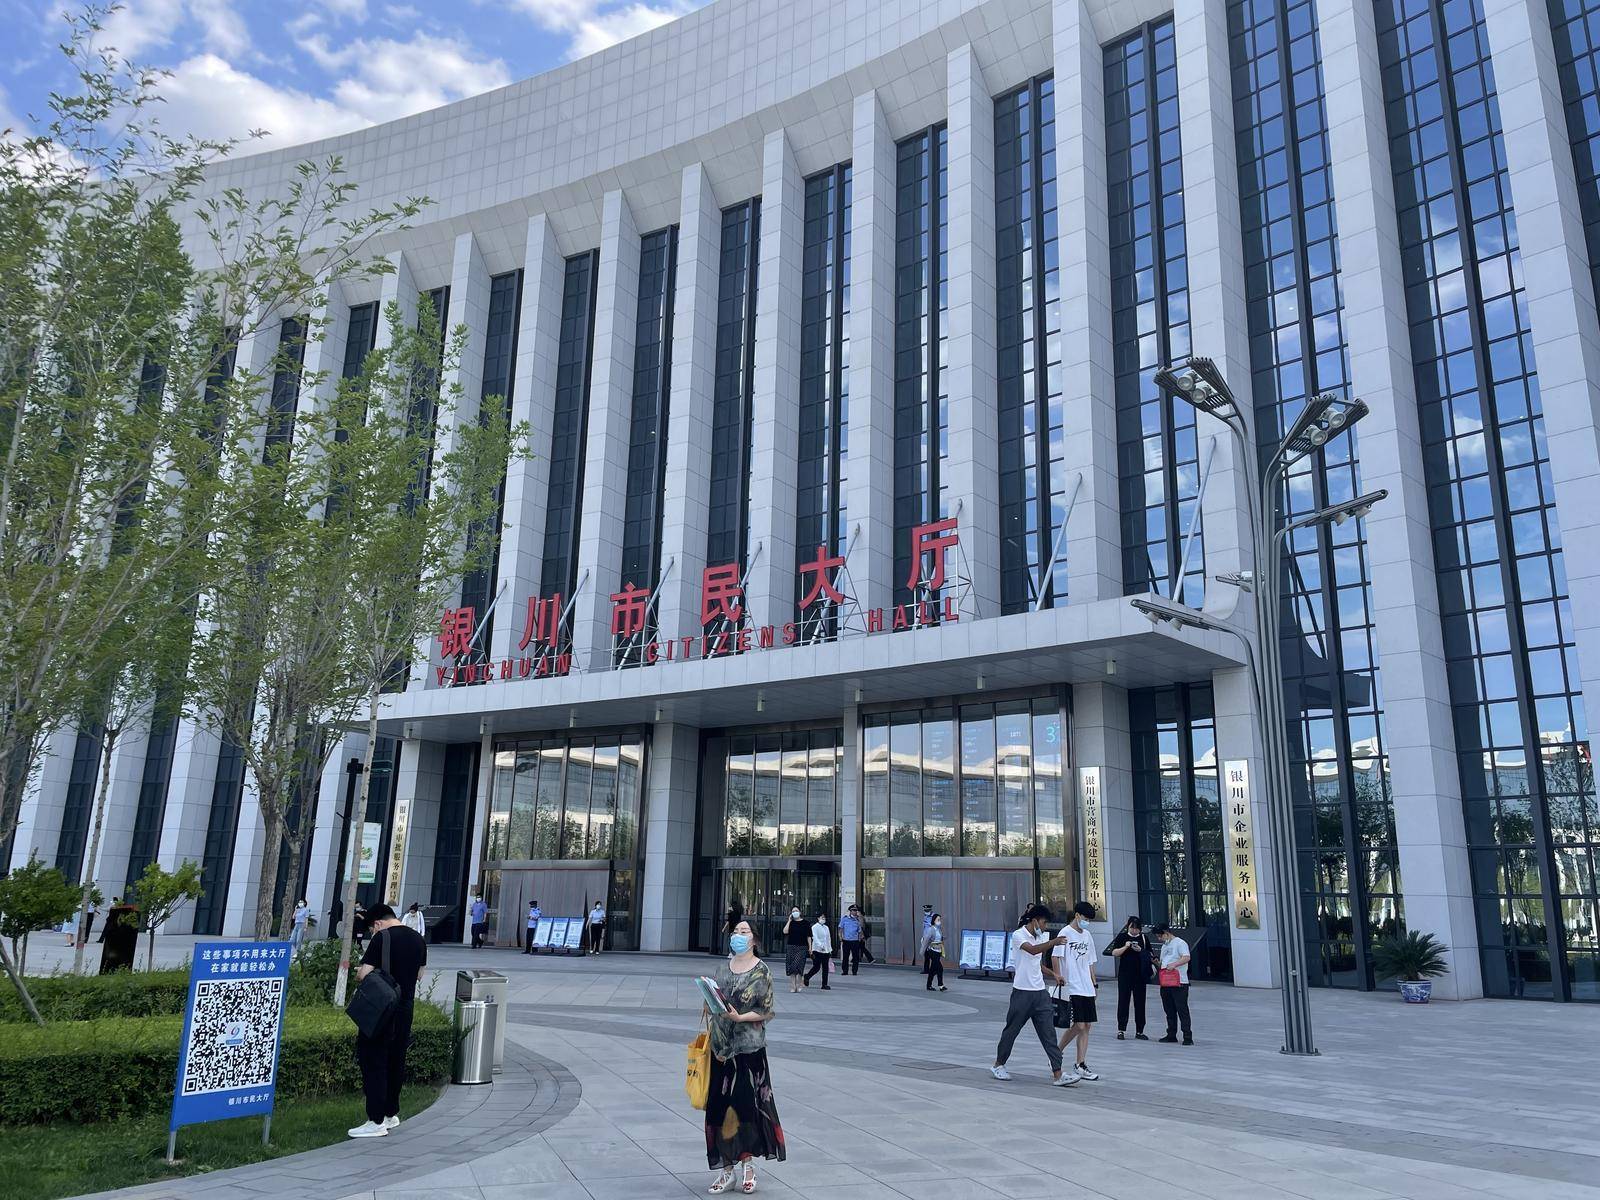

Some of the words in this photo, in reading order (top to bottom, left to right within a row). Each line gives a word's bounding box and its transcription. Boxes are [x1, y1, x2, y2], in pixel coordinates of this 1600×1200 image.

[437, 517, 958, 659] 银川市民大厅
[436, 653, 571, 686] YINCHUAN
[647, 623, 797, 663] CITIZENS
[868, 597, 959, 633] HALL
[1085, 775, 1100, 912] 银川市营商环境建设服务中心
[1230, 770, 1253, 919] 银川市企业服务中心
[202, 948, 287, 960] 这些事项不用来大厅
[210, 961, 276, 973] 在家就能轻松办
[228, 1093, 270, 1106] 银川市民大厅
